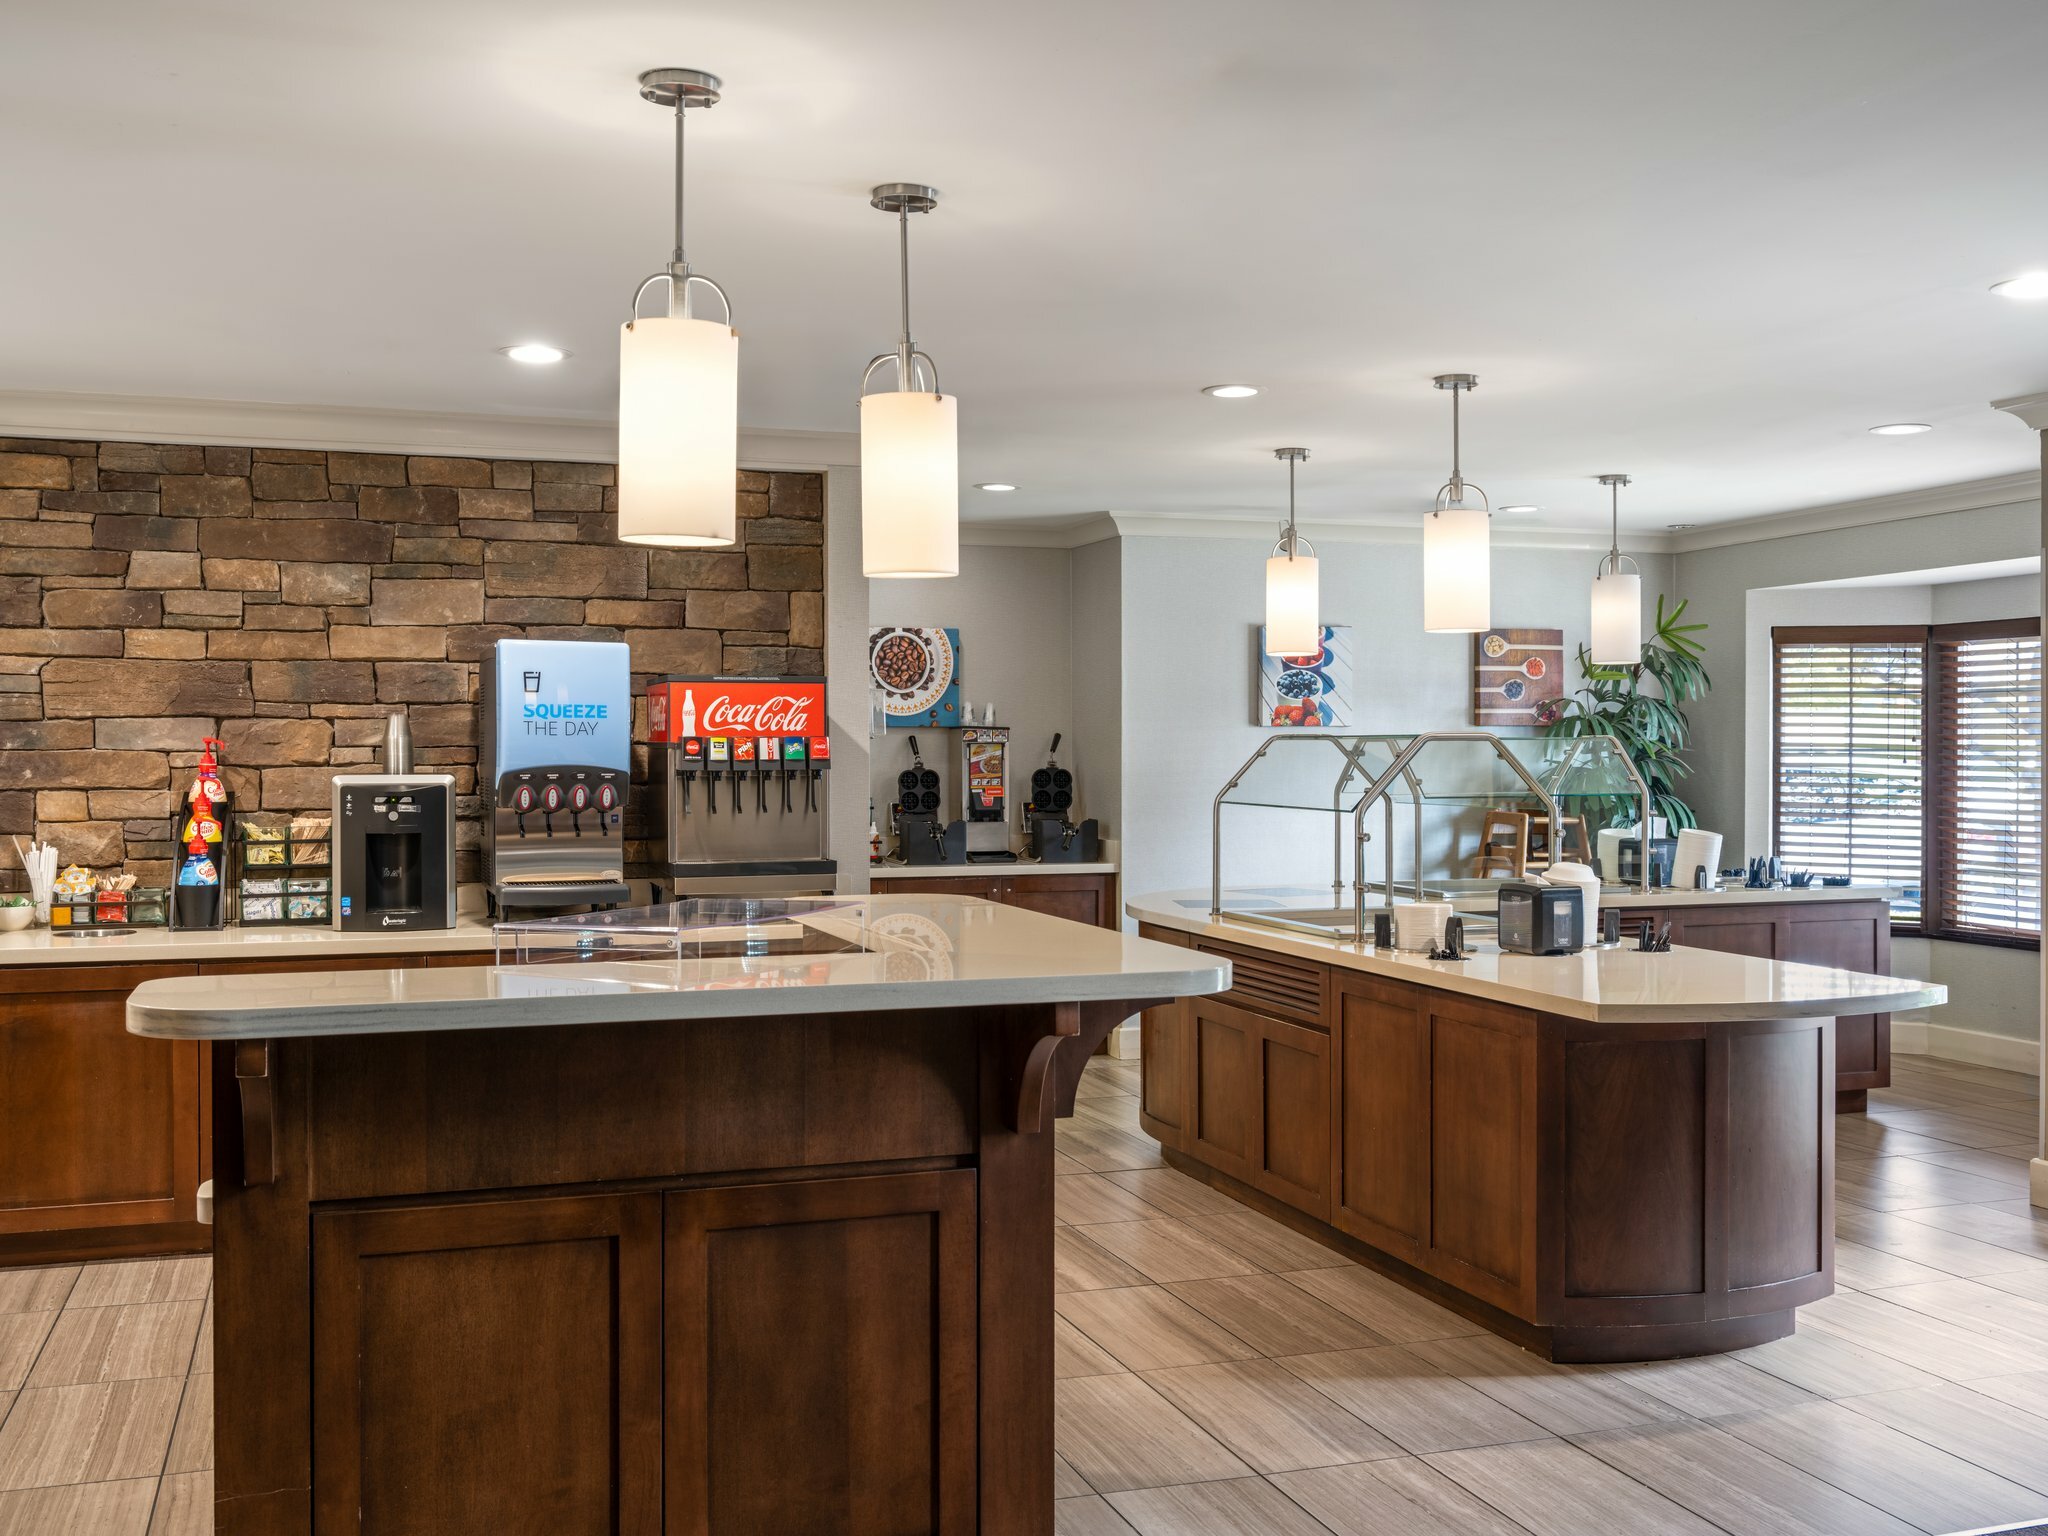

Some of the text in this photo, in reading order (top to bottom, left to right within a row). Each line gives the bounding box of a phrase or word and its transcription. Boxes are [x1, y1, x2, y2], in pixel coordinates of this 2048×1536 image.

[523, 703, 608, 719] SQUEEZE
[702, 695, 815, 732] Coca-Cola
[523, 720, 599, 736] THE DAY
[737, 741, 752, 756] Pibb
